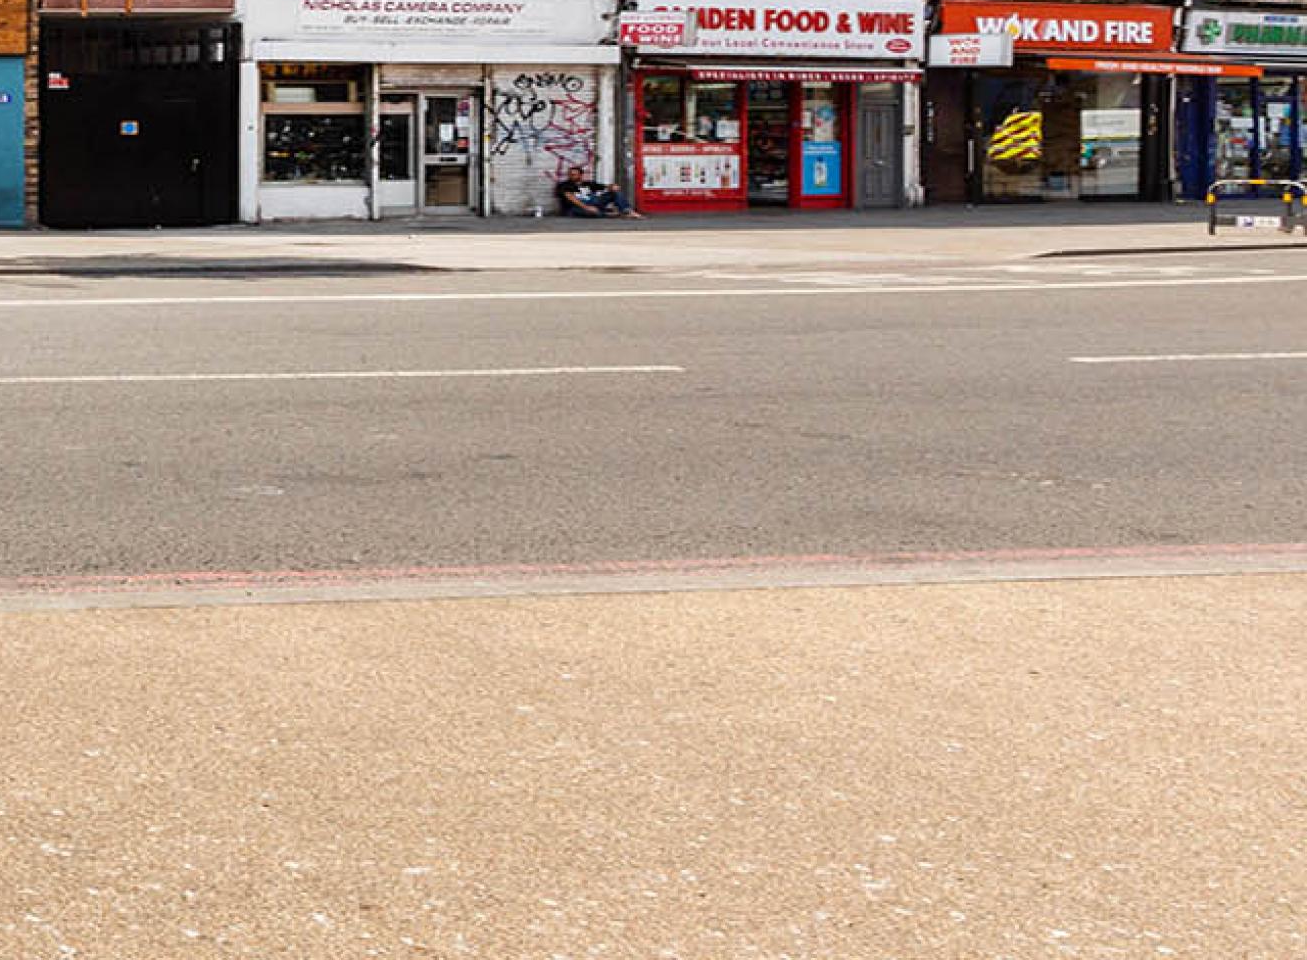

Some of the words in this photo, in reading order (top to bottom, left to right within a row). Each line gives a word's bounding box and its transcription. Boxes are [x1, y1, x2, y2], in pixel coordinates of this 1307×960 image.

[303, 0, 381, 12] NICHOLAS
[384, 0, 448, 13] CAMERA
[451, 1, 524, 14] COMPANY
[765, 8, 829, 32] FOOD
[836, 11, 852, 34] &
[857, 12, 916, 35] WINE
[1040, 20, 1099, 43] AND
[1103, 21, 1154, 44] FIRE
